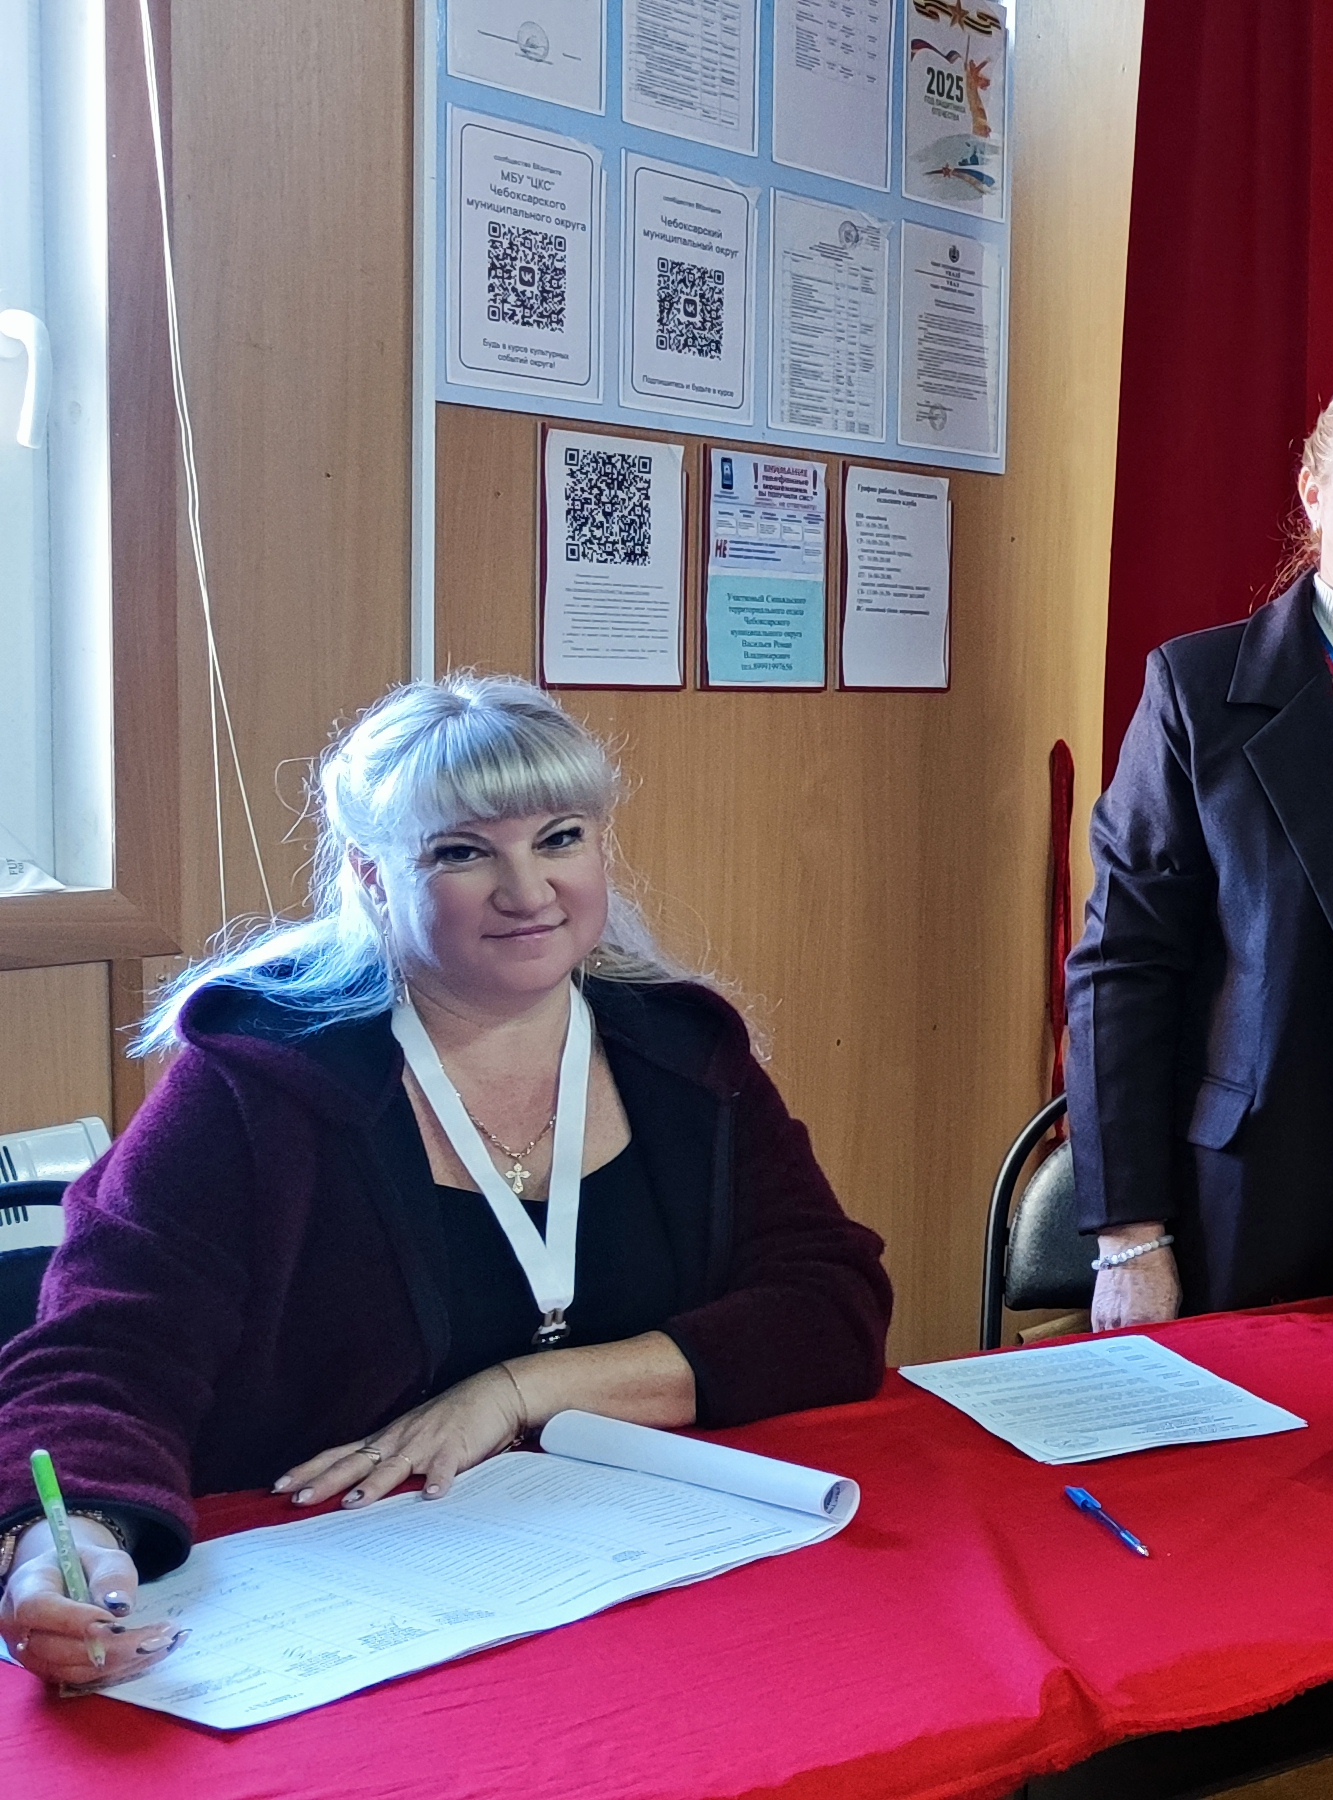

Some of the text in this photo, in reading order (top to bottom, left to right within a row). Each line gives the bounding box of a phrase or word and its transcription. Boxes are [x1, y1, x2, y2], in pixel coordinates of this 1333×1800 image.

[926, 66, 964, 103] 2025
[501, 170, 555, 191] МБУ "ЦКС"
[490, 183, 566, 211] Чебоксарского
[466, 198, 587, 232] муниципального округа
[660, 215, 723, 240] Чебоксарский
[643, 229, 739, 259] муниципальный округ
[482, 338, 500, 349] Будь
[508, 344, 528, 354] курсе
[530, 347, 569, 360] культурных
[498, 354, 528, 365] событий
